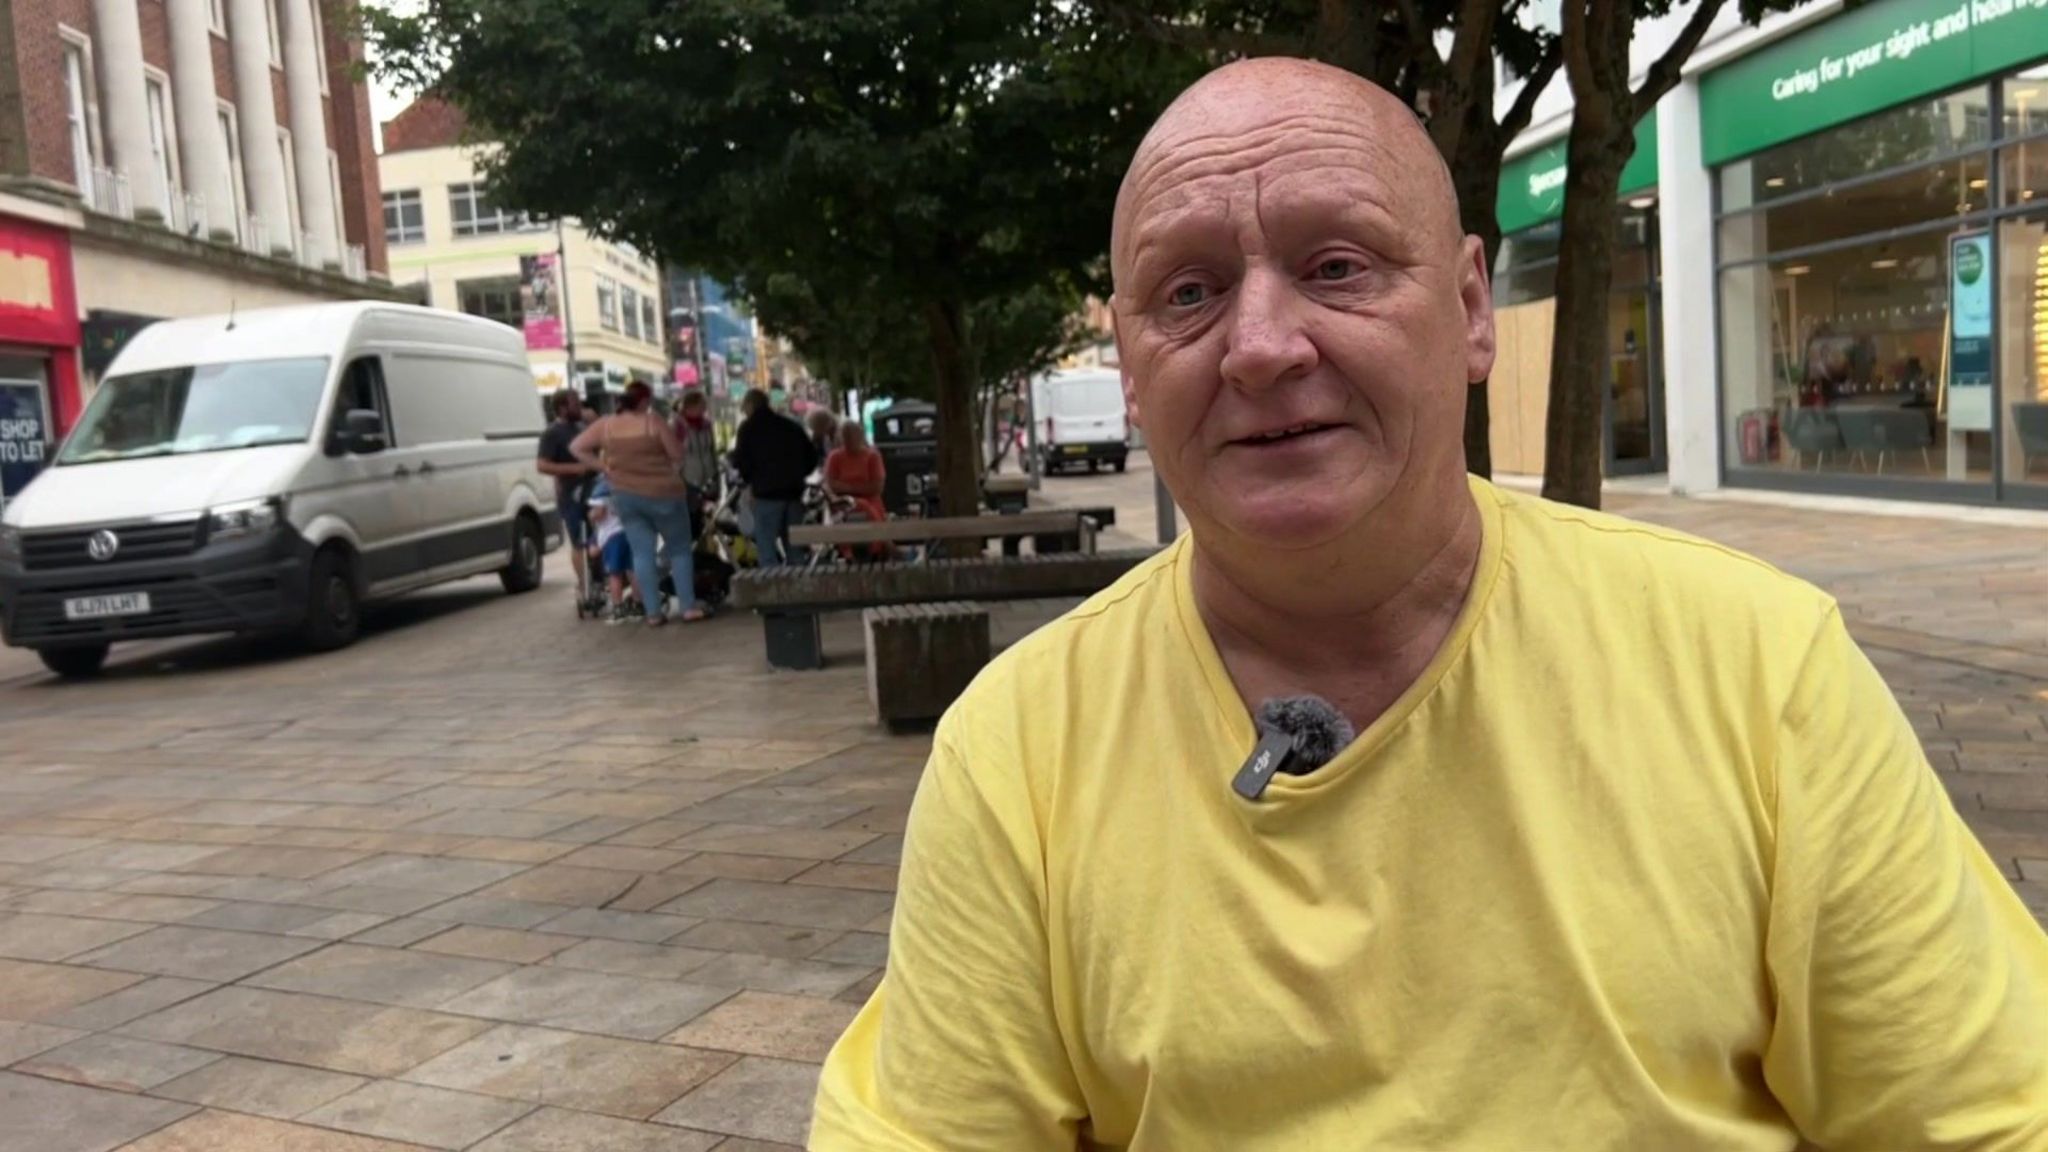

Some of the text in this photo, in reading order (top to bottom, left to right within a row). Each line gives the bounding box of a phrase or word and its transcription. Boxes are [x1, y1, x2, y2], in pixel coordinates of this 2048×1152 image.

[1772, 68, 1819, 100] Caring
[1820, 56, 1844, 83] for
[1846, 41, 1884, 78] your
[1885, 22, 1930, 59] sight
[1932, 3, 1968, 40] and
[1, 418, 39, 440] SHOP
[0, 440, 45, 463] TO LET
